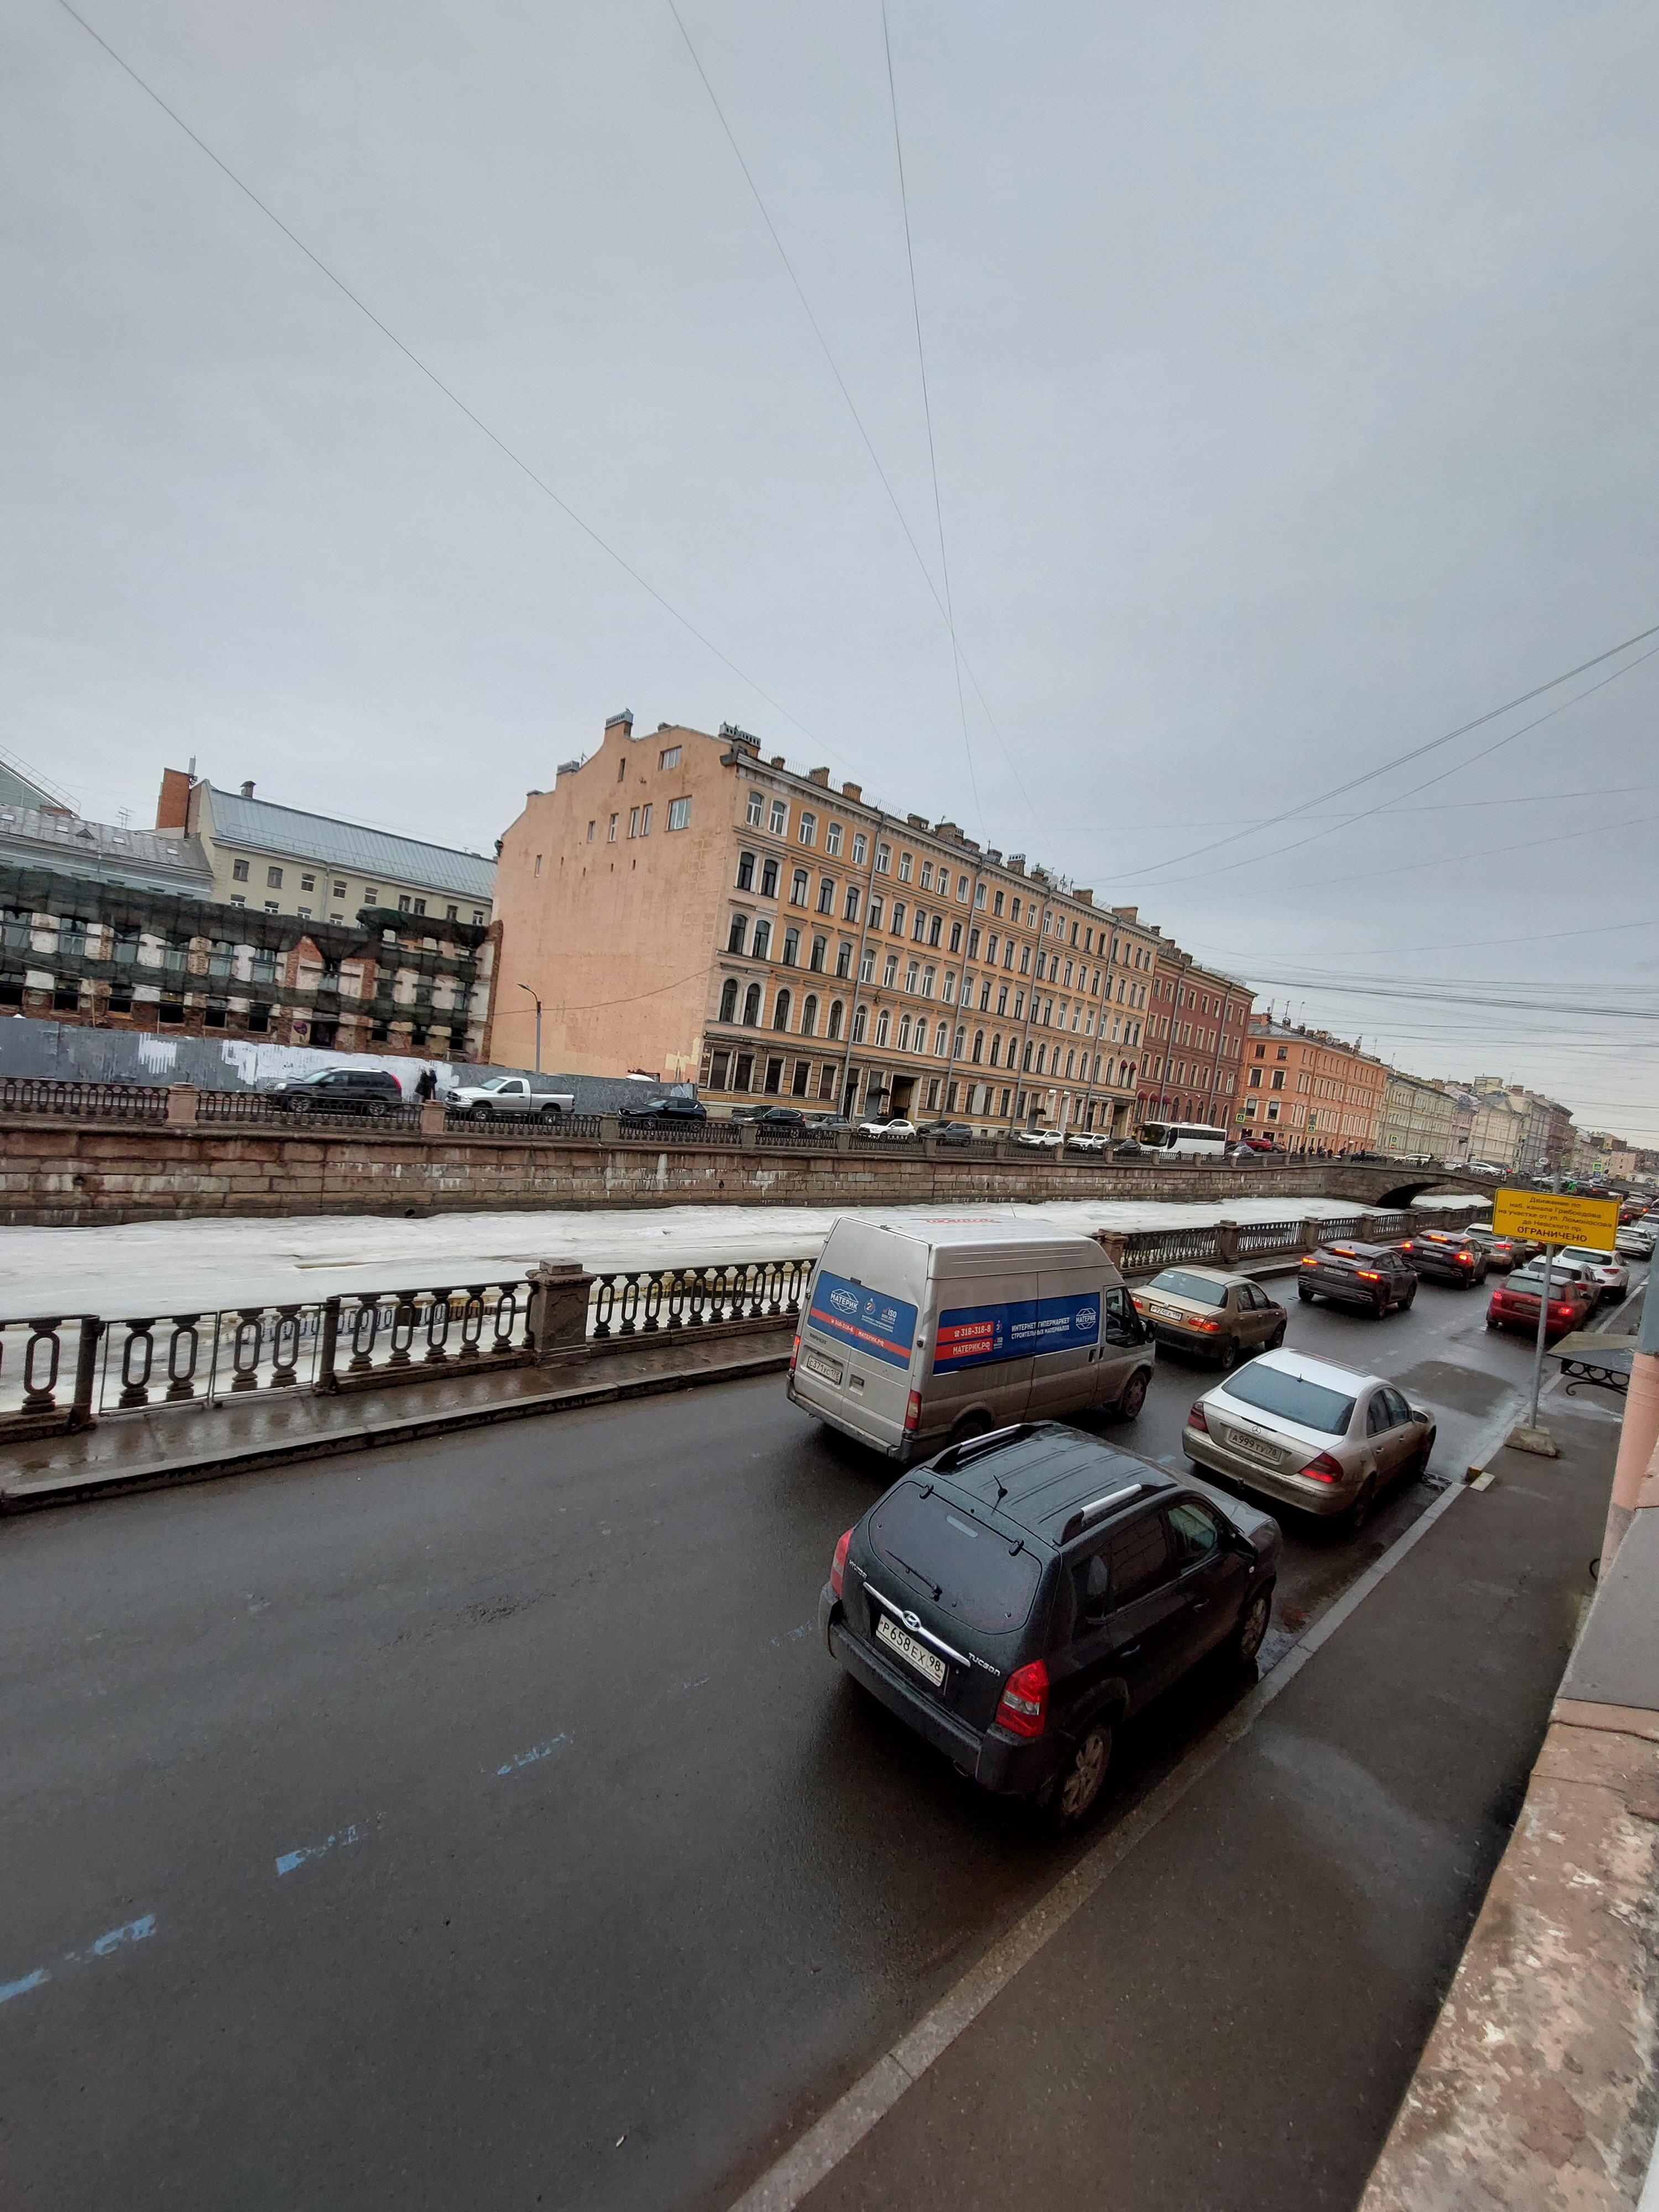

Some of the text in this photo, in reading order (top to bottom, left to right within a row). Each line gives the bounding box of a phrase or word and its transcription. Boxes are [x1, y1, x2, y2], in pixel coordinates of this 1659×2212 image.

[1529, 1197, 1569, 1207] Движение
[1555, 1207, 1601, 1219] Грибоедова
[1534, 1220, 1569, 1230] Невского
[1562, 1216, 1612, 1228] Ломоносова
[1516, 1226, 1588, 1243] ОГРАНИЧЕНО
[830, 1293, 858, 1310] МАТЕРИК
[888, 1308, 897, 1318] ISO
[1076, 1314, 1097, 1324] МАТЕРИК
[961, 1324, 992, 1337] 318-318-8
[1011, 1317, 1070, 1332] ИНТЕРНЕТ ГИПЕРМАРКЕТ
[953, 1341, 990, 1355] МАТЕРИК.РФ
[883, 1622, 926, 1665] Р658ЕХ
[929, 1656, 941, 1671] 98
[968, 1652, 1000, 1677] TUCSON
